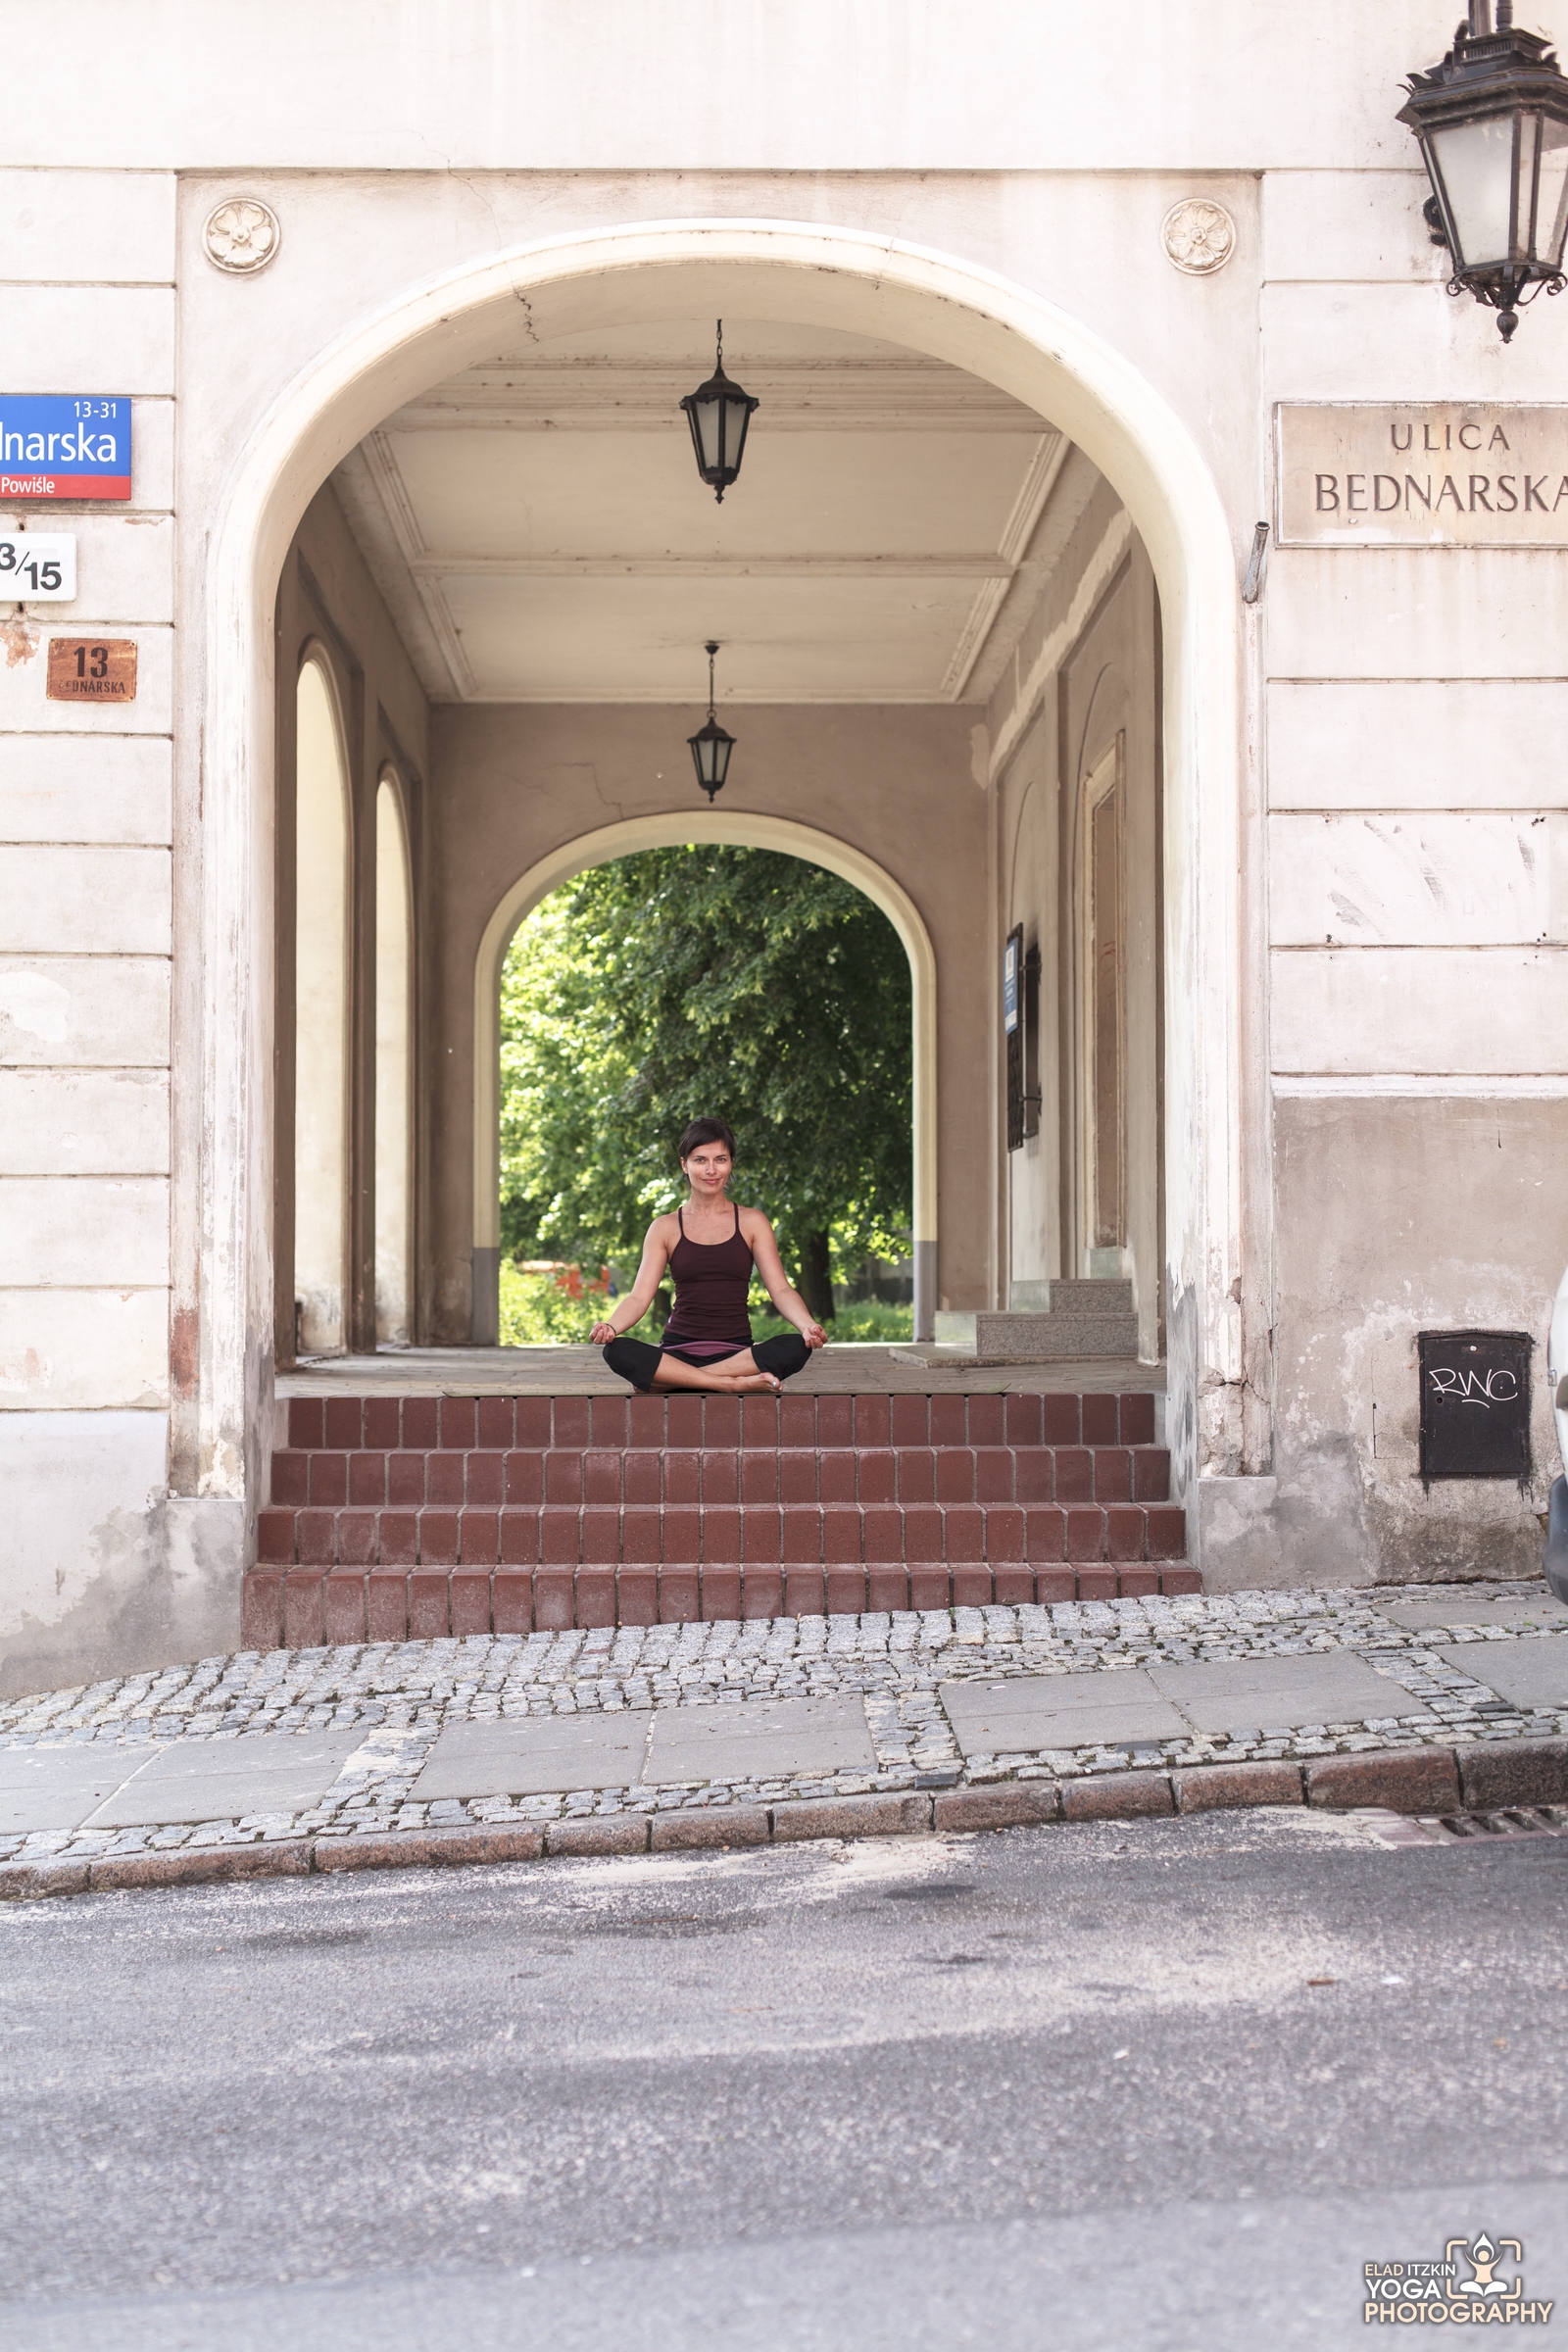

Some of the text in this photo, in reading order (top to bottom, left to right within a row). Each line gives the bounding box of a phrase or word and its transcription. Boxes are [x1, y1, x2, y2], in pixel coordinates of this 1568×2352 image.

[74, 401, 117, 418] 13-31
[0, 421, 117, 463] narska
[1391, 423, 1511, 451] ULICA
[1, 475, 56, 494] Powiśle
[1315, 473, 1568, 513] BEDNARSKA
[74, 645, 109, 678] 13
[58, 679, 125, 694] EDNARSKA
